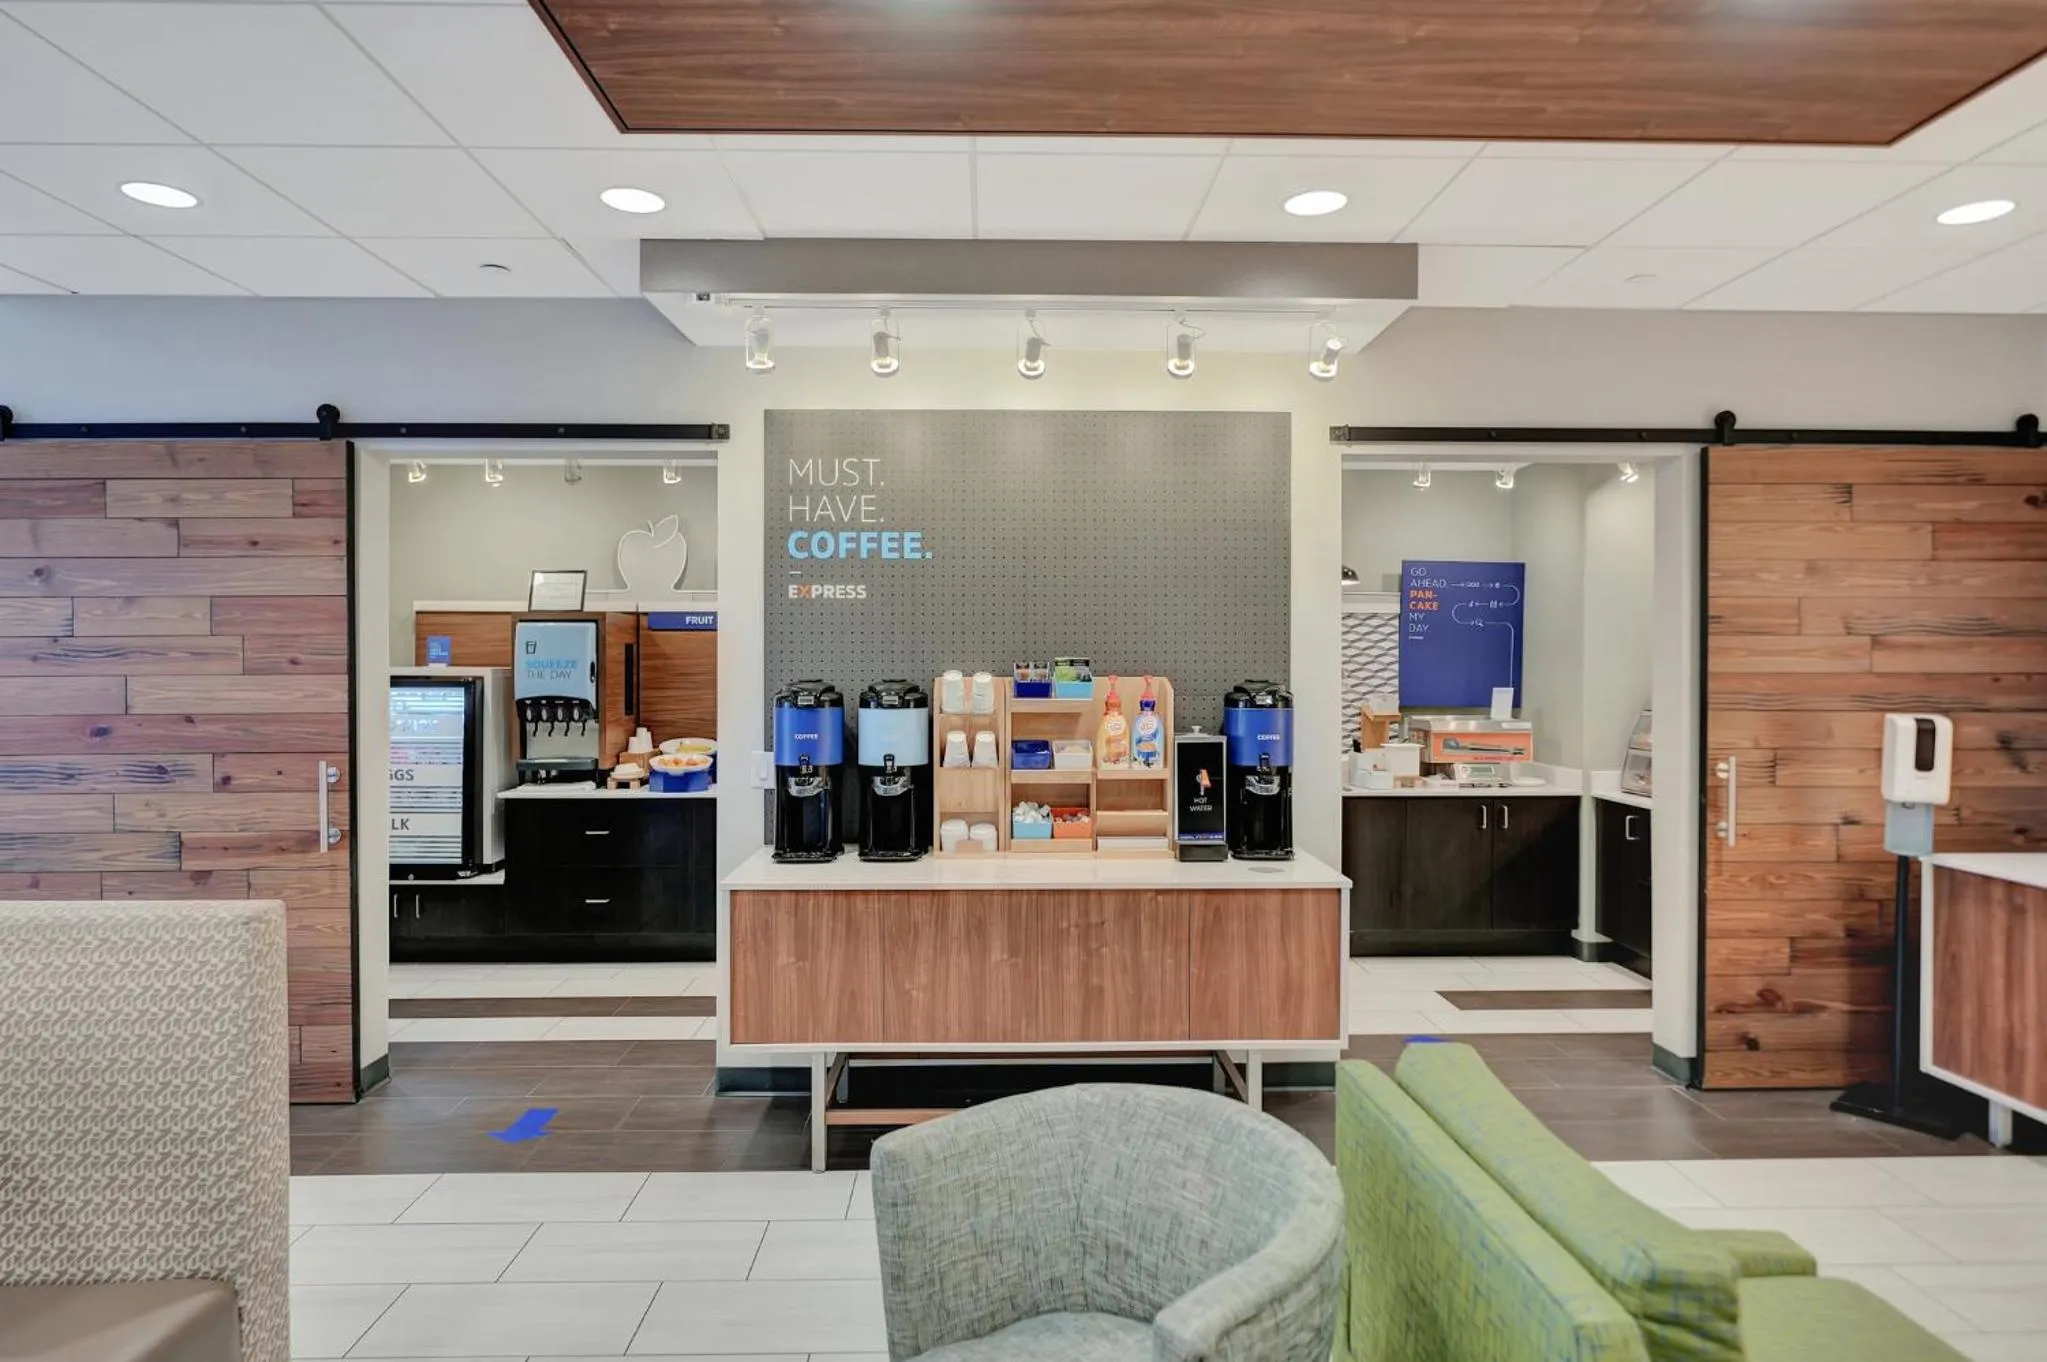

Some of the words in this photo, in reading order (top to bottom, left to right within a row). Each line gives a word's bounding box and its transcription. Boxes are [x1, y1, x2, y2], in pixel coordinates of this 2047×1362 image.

[789, 457, 885, 487] MUST.
[789, 495, 885, 523] HAVE.
[787, 530, 933, 560] COFFEE.
[1410, 567, 1427, 577] GO
[1410, 579, 1447, 588] AHEAD
[788, 584, 867, 599] EXPRESS
[1409, 590, 1439, 599] PAN-
[1409, 601, 1439, 611] CAKE
[685, 616, 714, 625] FRUIT
[1409, 612, 1425, 621] MY
